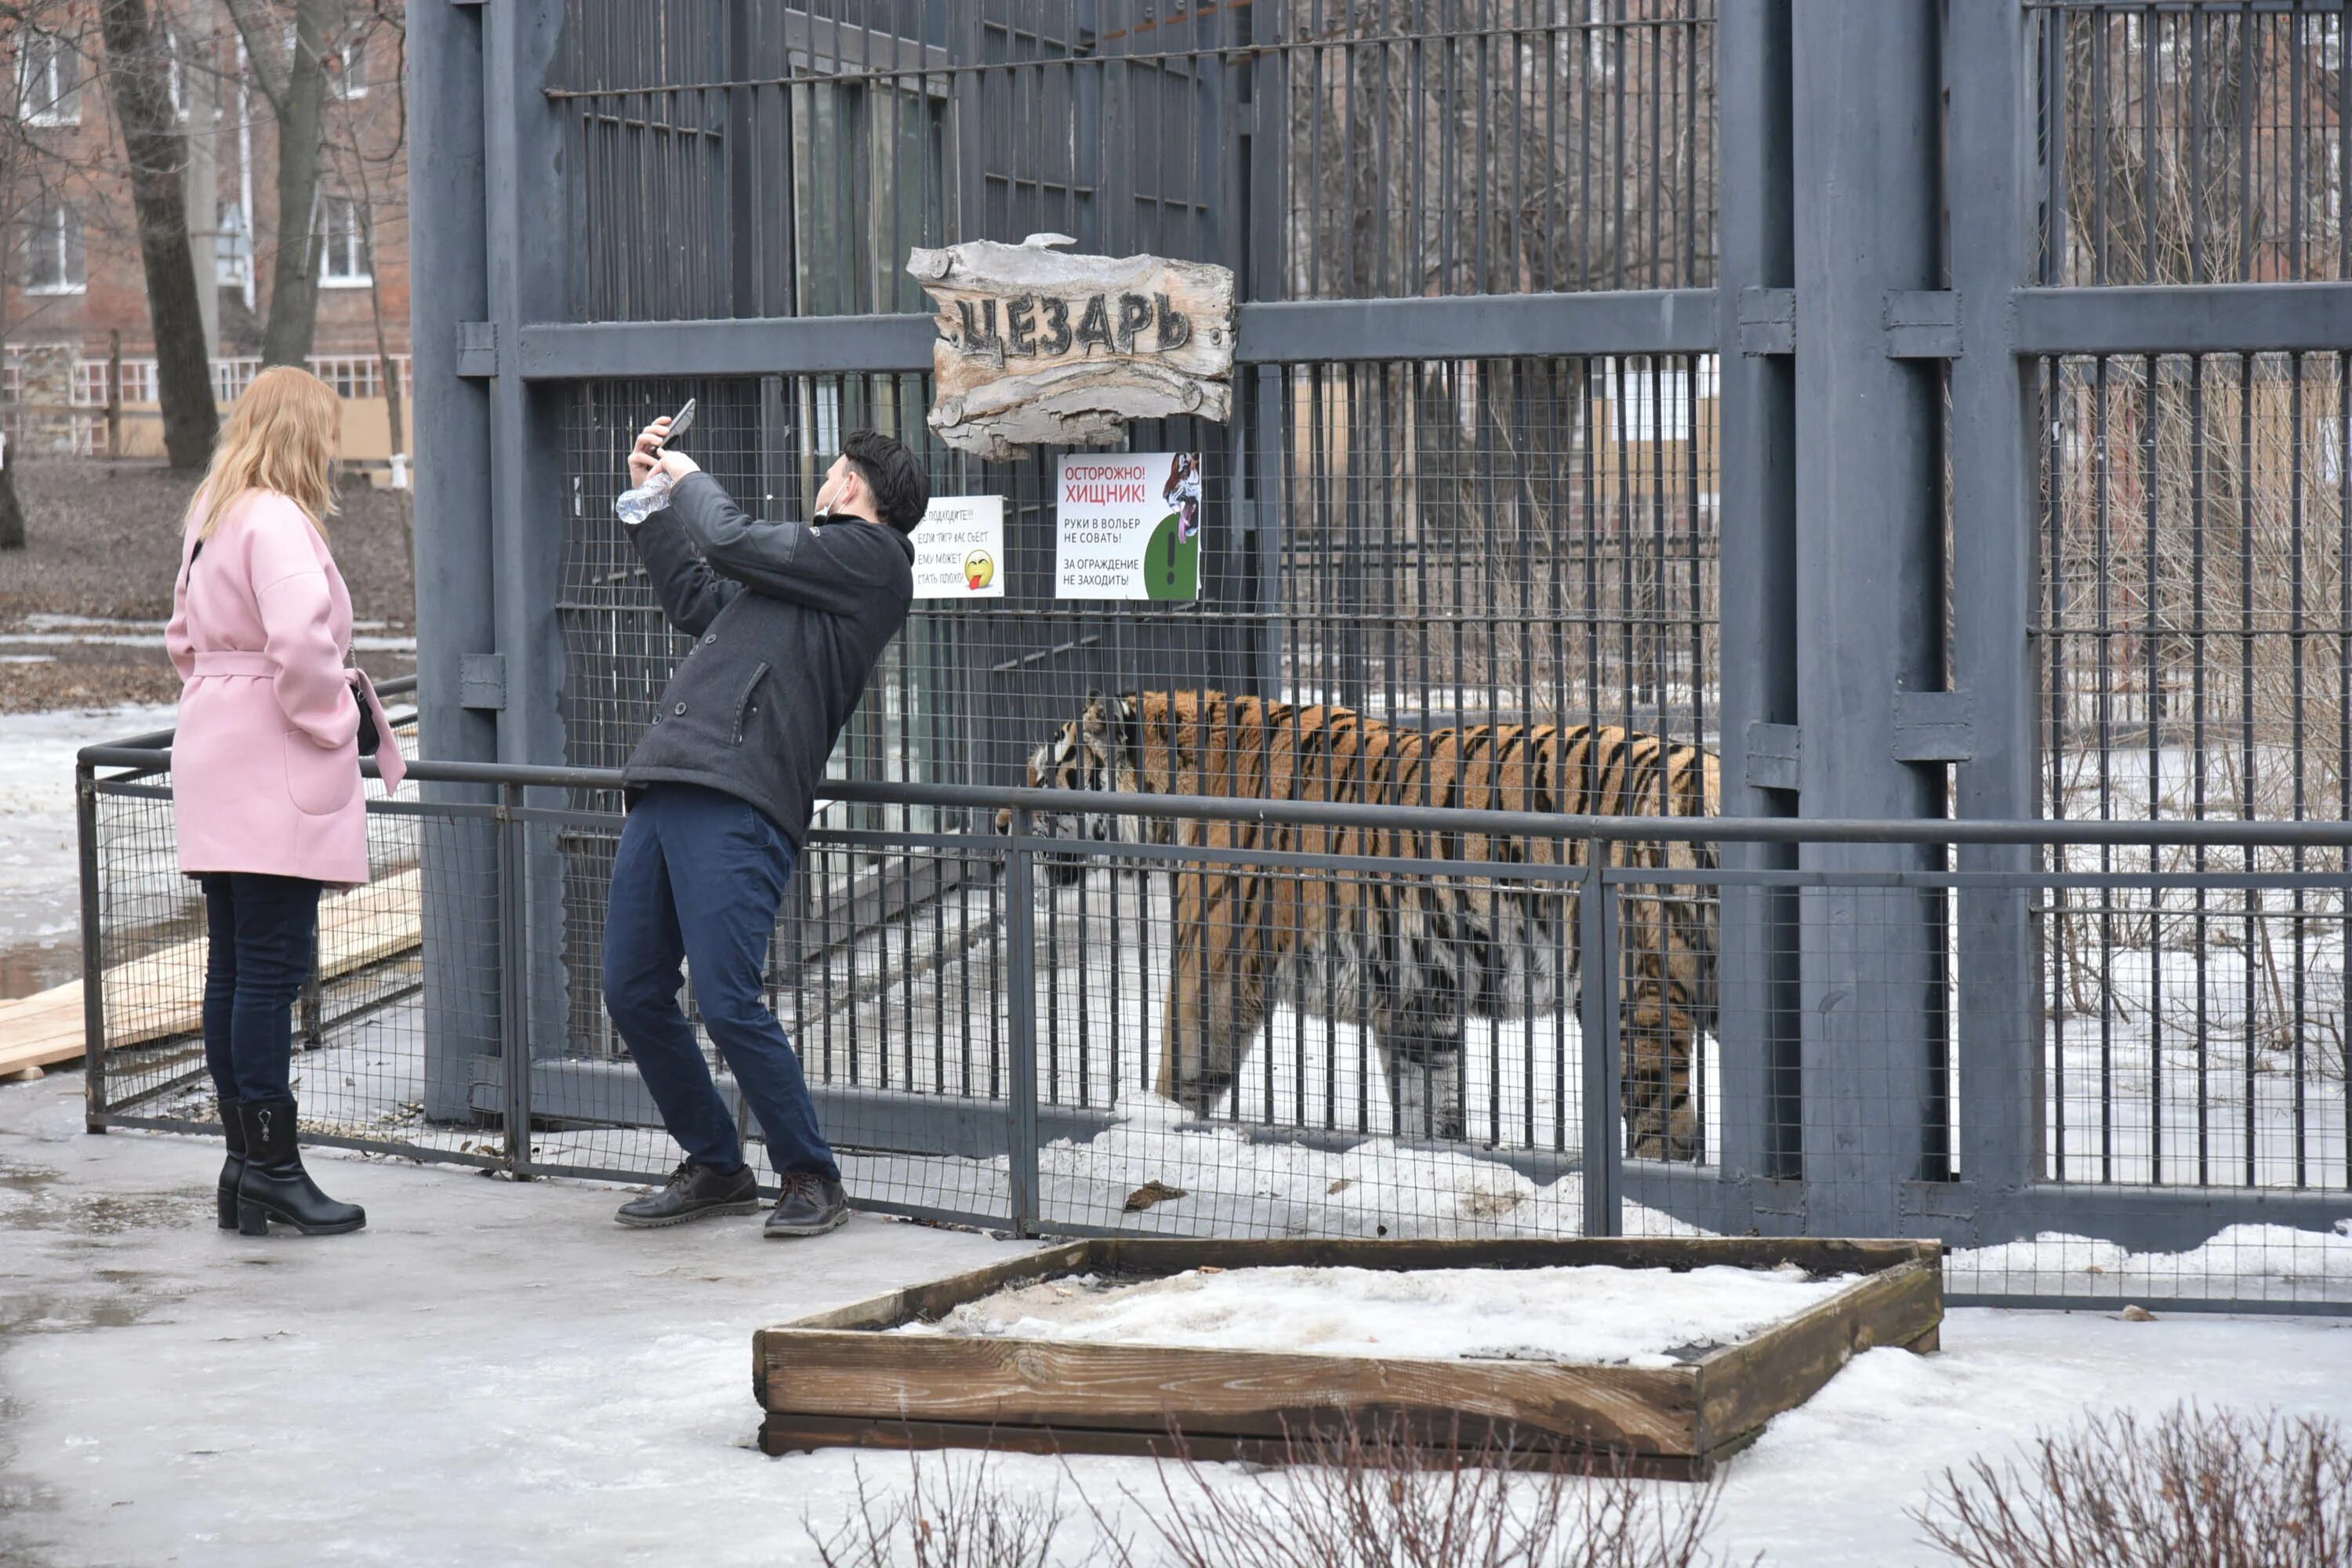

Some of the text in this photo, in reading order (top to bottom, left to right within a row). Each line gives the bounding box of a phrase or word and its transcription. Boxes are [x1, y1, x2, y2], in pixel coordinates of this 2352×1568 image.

[956, 292, 1190, 368] ЦЕЗАРЬ
[1065, 466, 1145, 481] ОСТОРОЖНО!
[1065, 485, 1145, 506] ХИЩНИК!
[1064, 519, 1141, 529] РУКИ В ВОЛЬЕР
[918, 534, 935, 544] ЕСЛИ
[937, 533, 953, 543] ТИГР
[1064, 533, 1121, 543] НЕ СОВАТЬ!
[918, 553, 961, 564] ЕМУ МОЖЕТ
[1064, 559, 1139, 571] ЗА ОГРАЖДЕНИЕ
[918, 572, 964, 584] СТАТЬ ПЛОХО!
[1063, 575, 1129, 586] НЕ ЗАХОДИТЬ!
